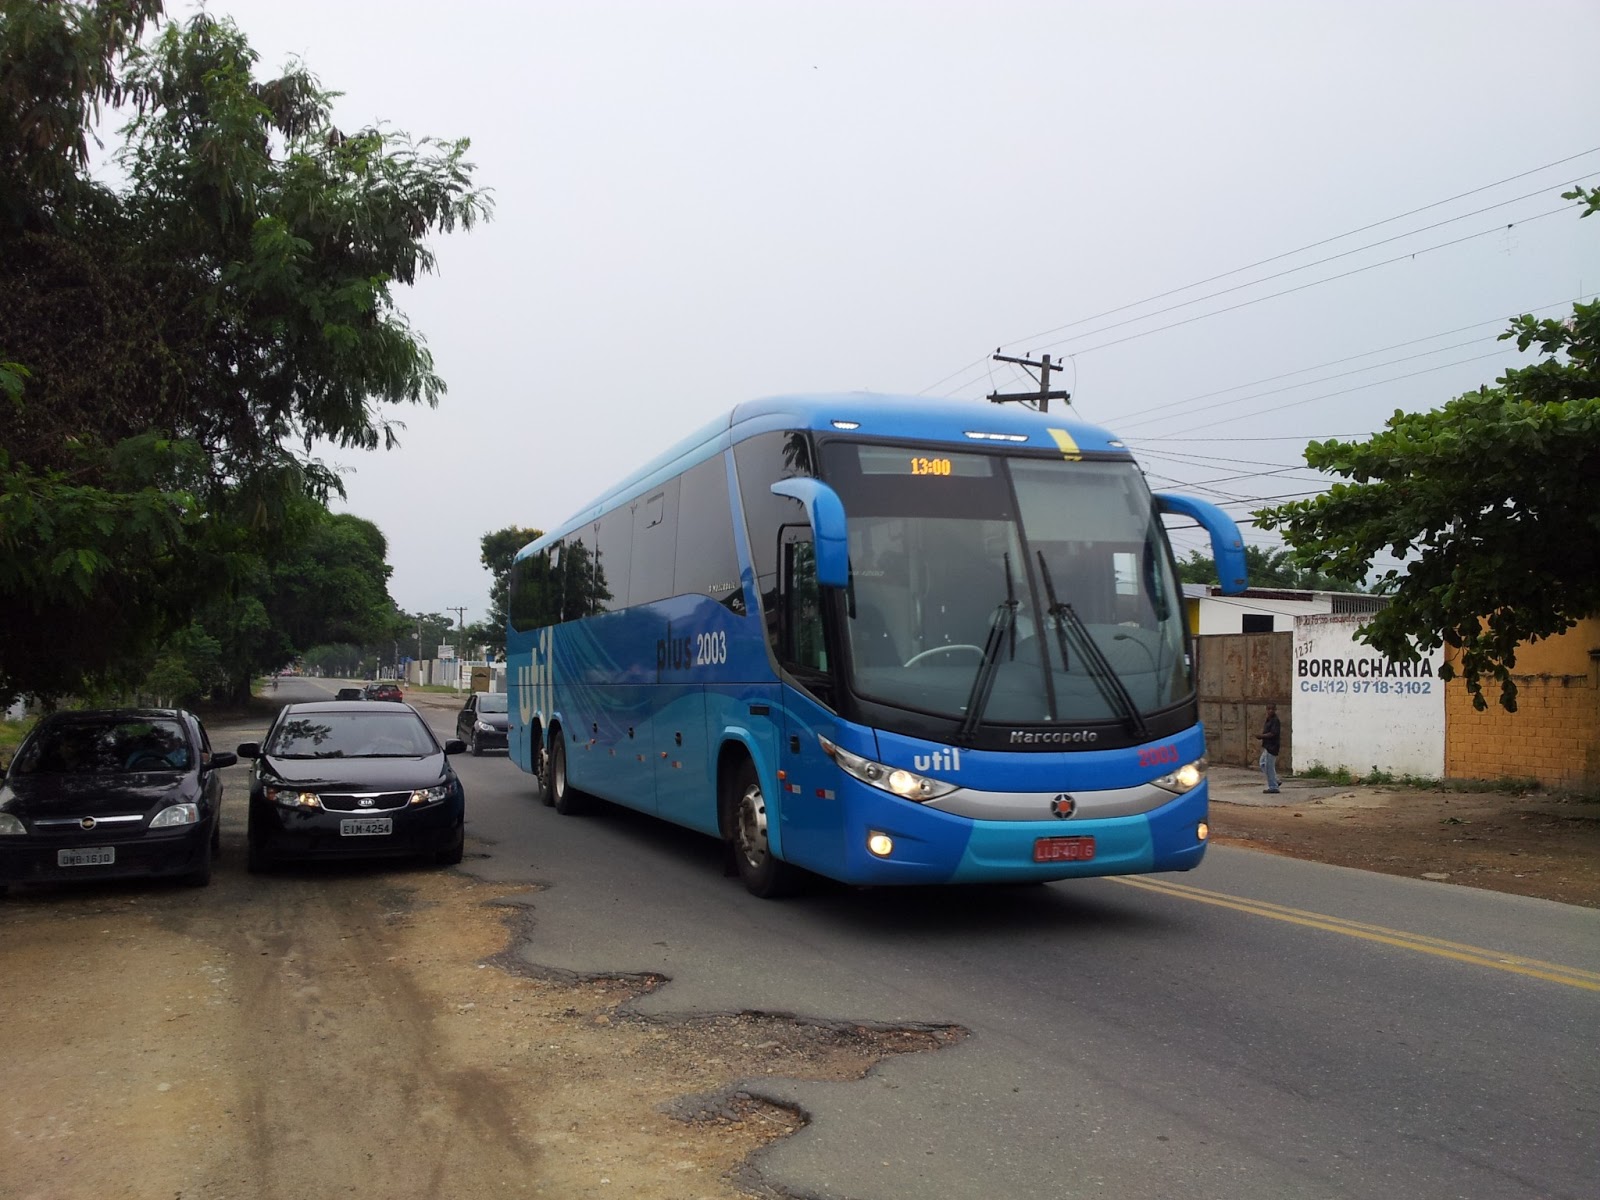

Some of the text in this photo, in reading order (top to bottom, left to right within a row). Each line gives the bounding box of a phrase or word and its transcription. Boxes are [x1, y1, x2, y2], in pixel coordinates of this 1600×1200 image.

[911, 457, 951, 476] 13:00
[656, 618, 727, 684] plus 2003
[1295, 640, 1313, 658] 1237
[518, 625, 554, 729] util
[1298, 658, 1433, 677] BORRACHARIA
[1352, 680, 1432, 695] 9718-3102
[1010, 730, 1098, 744] Marcopolo
[914, 748, 961, 772] util
